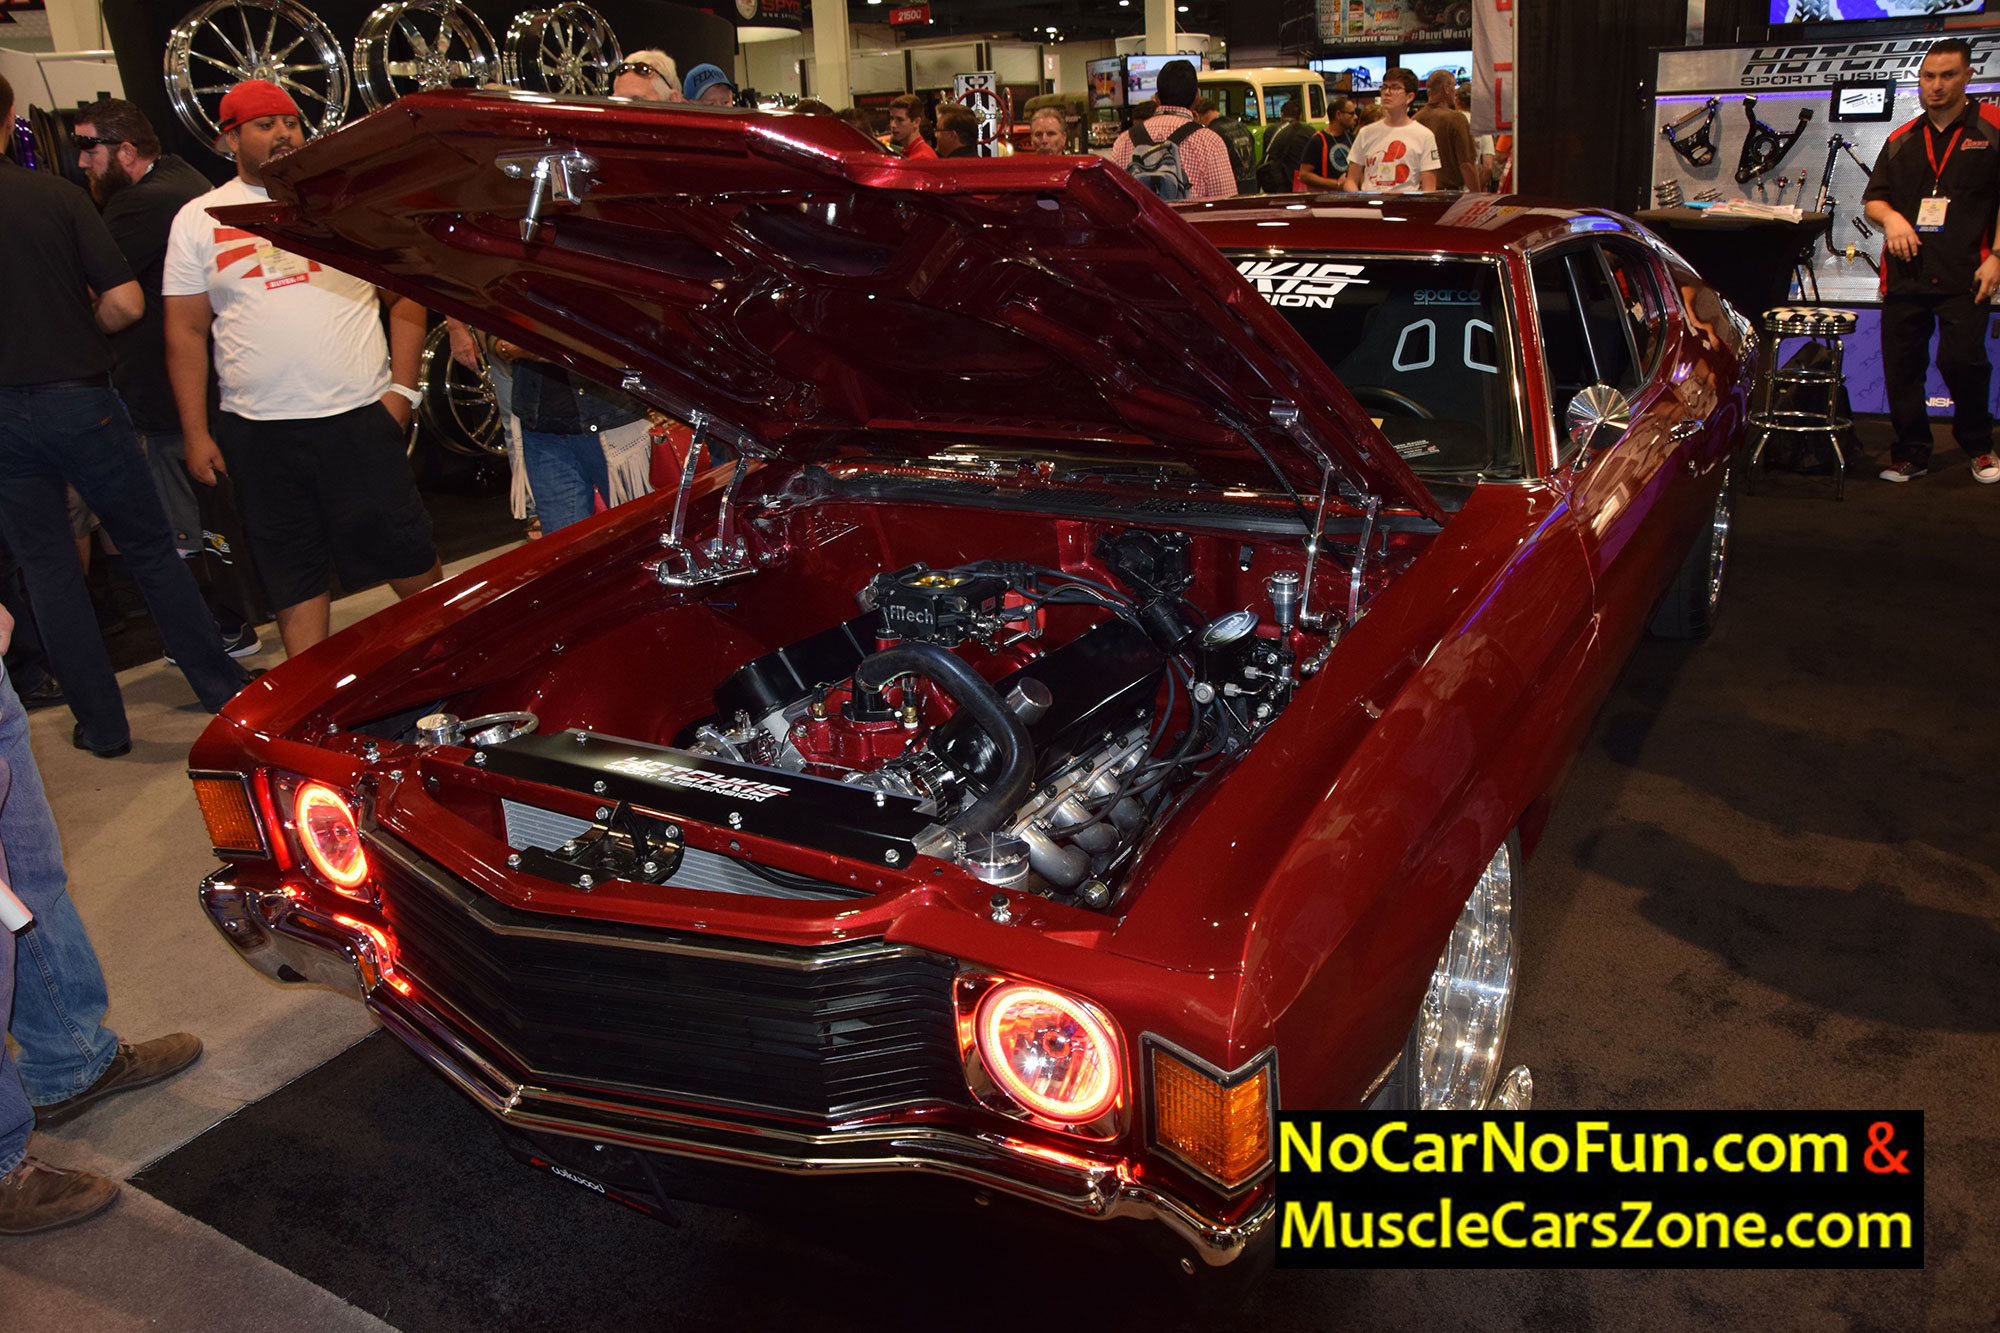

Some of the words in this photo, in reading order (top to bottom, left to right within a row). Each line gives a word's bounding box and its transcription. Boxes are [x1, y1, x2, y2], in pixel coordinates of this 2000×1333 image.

[1740, 74, 1817, 87] SPORT
[1413, 288, 1481, 305] sparco
[603, 763, 658, 778] SPORT
[657, 775, 766, 802] SUSPENSION
